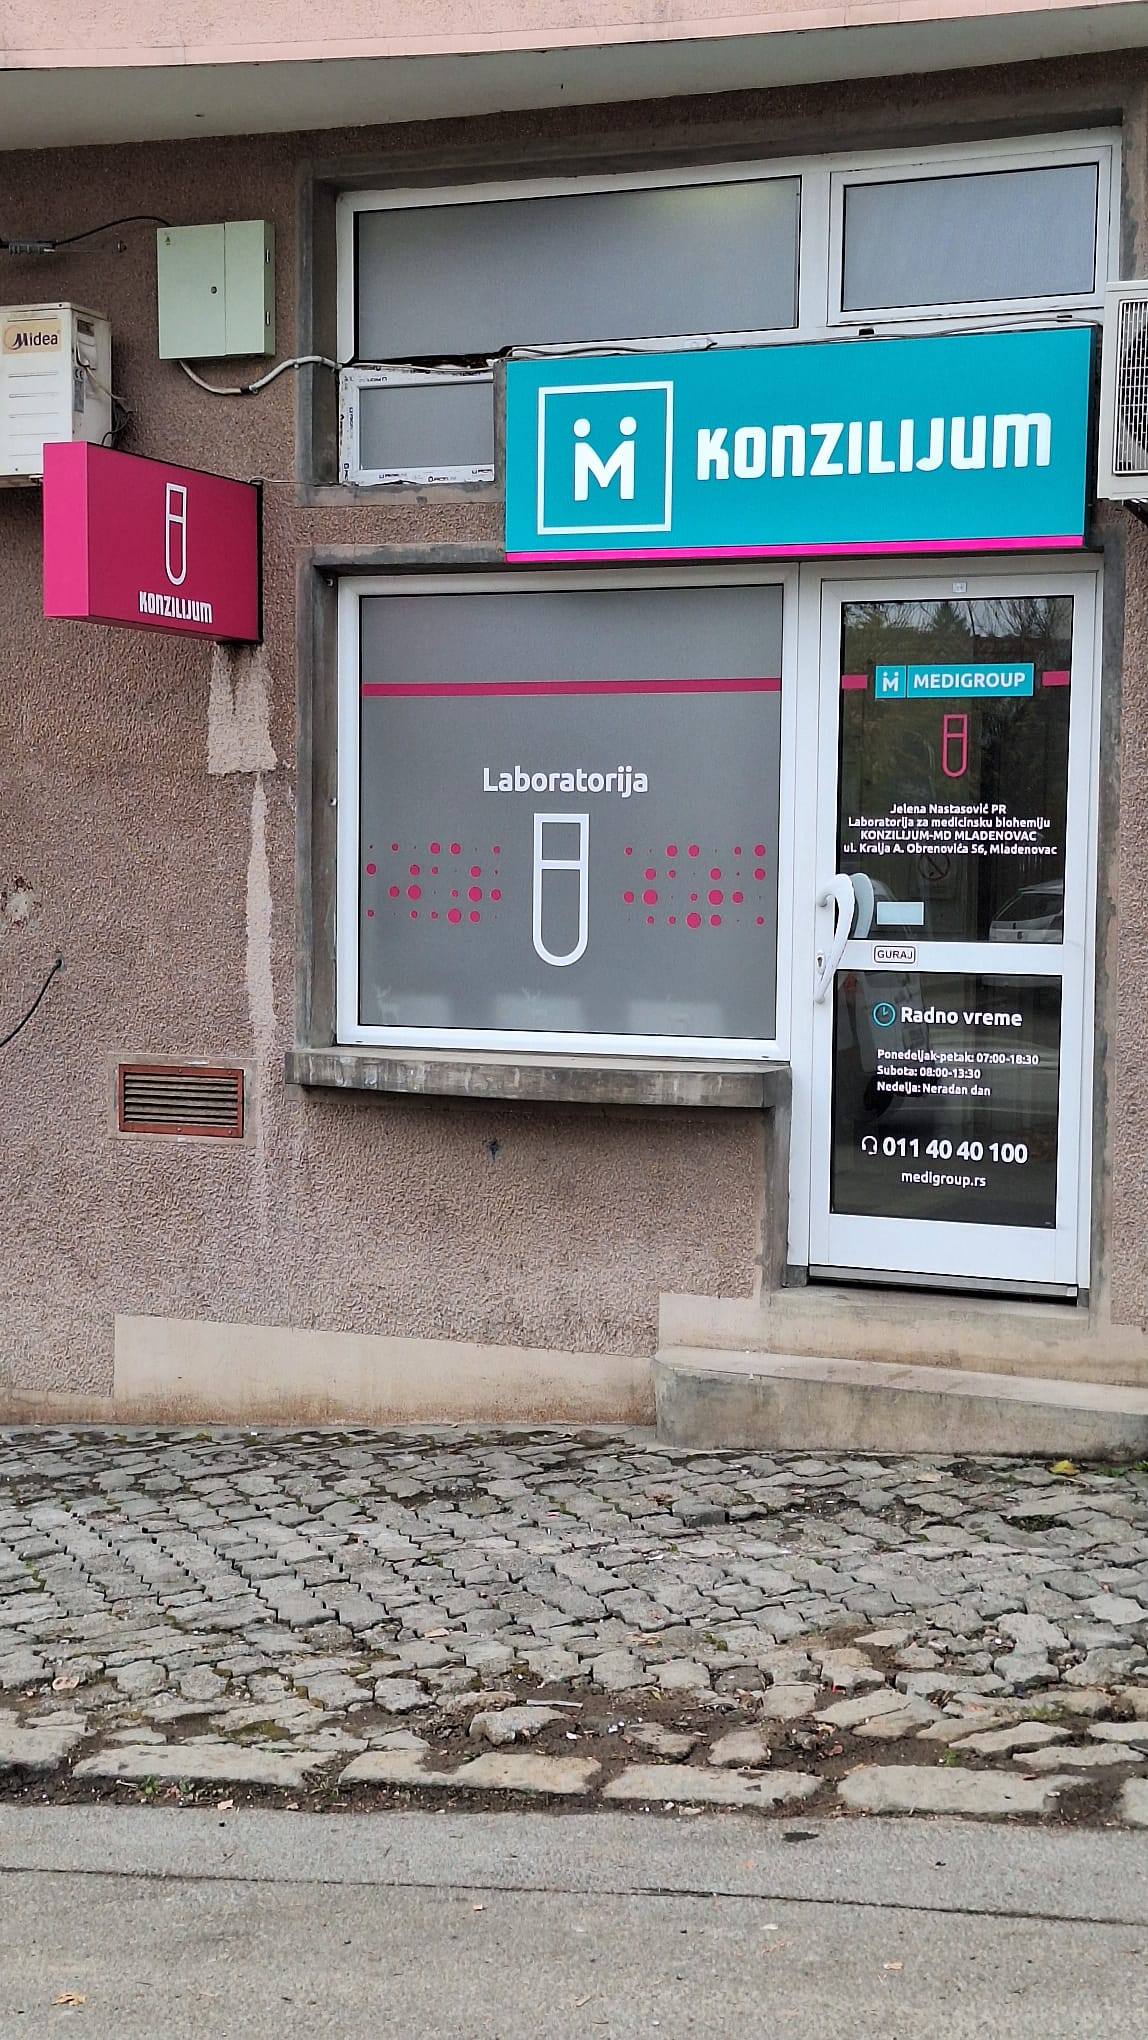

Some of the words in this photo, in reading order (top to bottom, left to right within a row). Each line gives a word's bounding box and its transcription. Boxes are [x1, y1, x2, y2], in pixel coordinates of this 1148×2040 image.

[12, 332, 58, 350] Midea
[697, 412, 1052, 481] KONZILIJUM
[139, 590, 213, 624] KONZILIJUM
[913, 672, 1026, 689] MEDIGROUP
[482, 765, 649, 798] Laboratorija
[890, 803, 927, 814] Jelena
[929, 803, 989, 814] Nastasović
[991, 804, 1007, 814] PR
[848, 816, 914, 829] Laboratorija
[916, 819, 929, 827] za
[931, 816, 993, 828] medicinsku
[995, 816, 1051, 830] biohemiju
[860, 830, 952, 840] KONZILIJUM-MD
[954, 830, 1037, 841] MLADENOVAC
[843, 842, 857, 853] ul.
[859, 842, 891, 855] Kralja
[892, 843, 905, 853] A.
[906, 842, 969, 854] Obrenovića
[970, 843, 988, 856] 56,
[989, 843, 1058, 855] Mladenovac
[877, 949, 913, 960] GURAJ
[901, 1006, 957, 1025] Radno
[963, 1011, 1023, 1027] vreme
[877, 1049, 975, 1063] Ponedeljak-petak:
[976, 1053, 1039, 1065] 07:00-18:30
[876, 1065, 918, 1077] Subota:
[919, 1067, 981, 1079] 08:00-13:30
[876, 1081, 921, 1095] Nedelja:
[922, 1083, 968, 1096] Neradan
[970, 1085, 991, 1097] dan
[883, 1137, 919, 1157] 011
[926, 1138, 952, 1159] 40
[957, 1140, 984, 1161] 40
[989, 1142, 1028, 1164] 100
[901, 1171, 986, 1188] medigroup.rs
